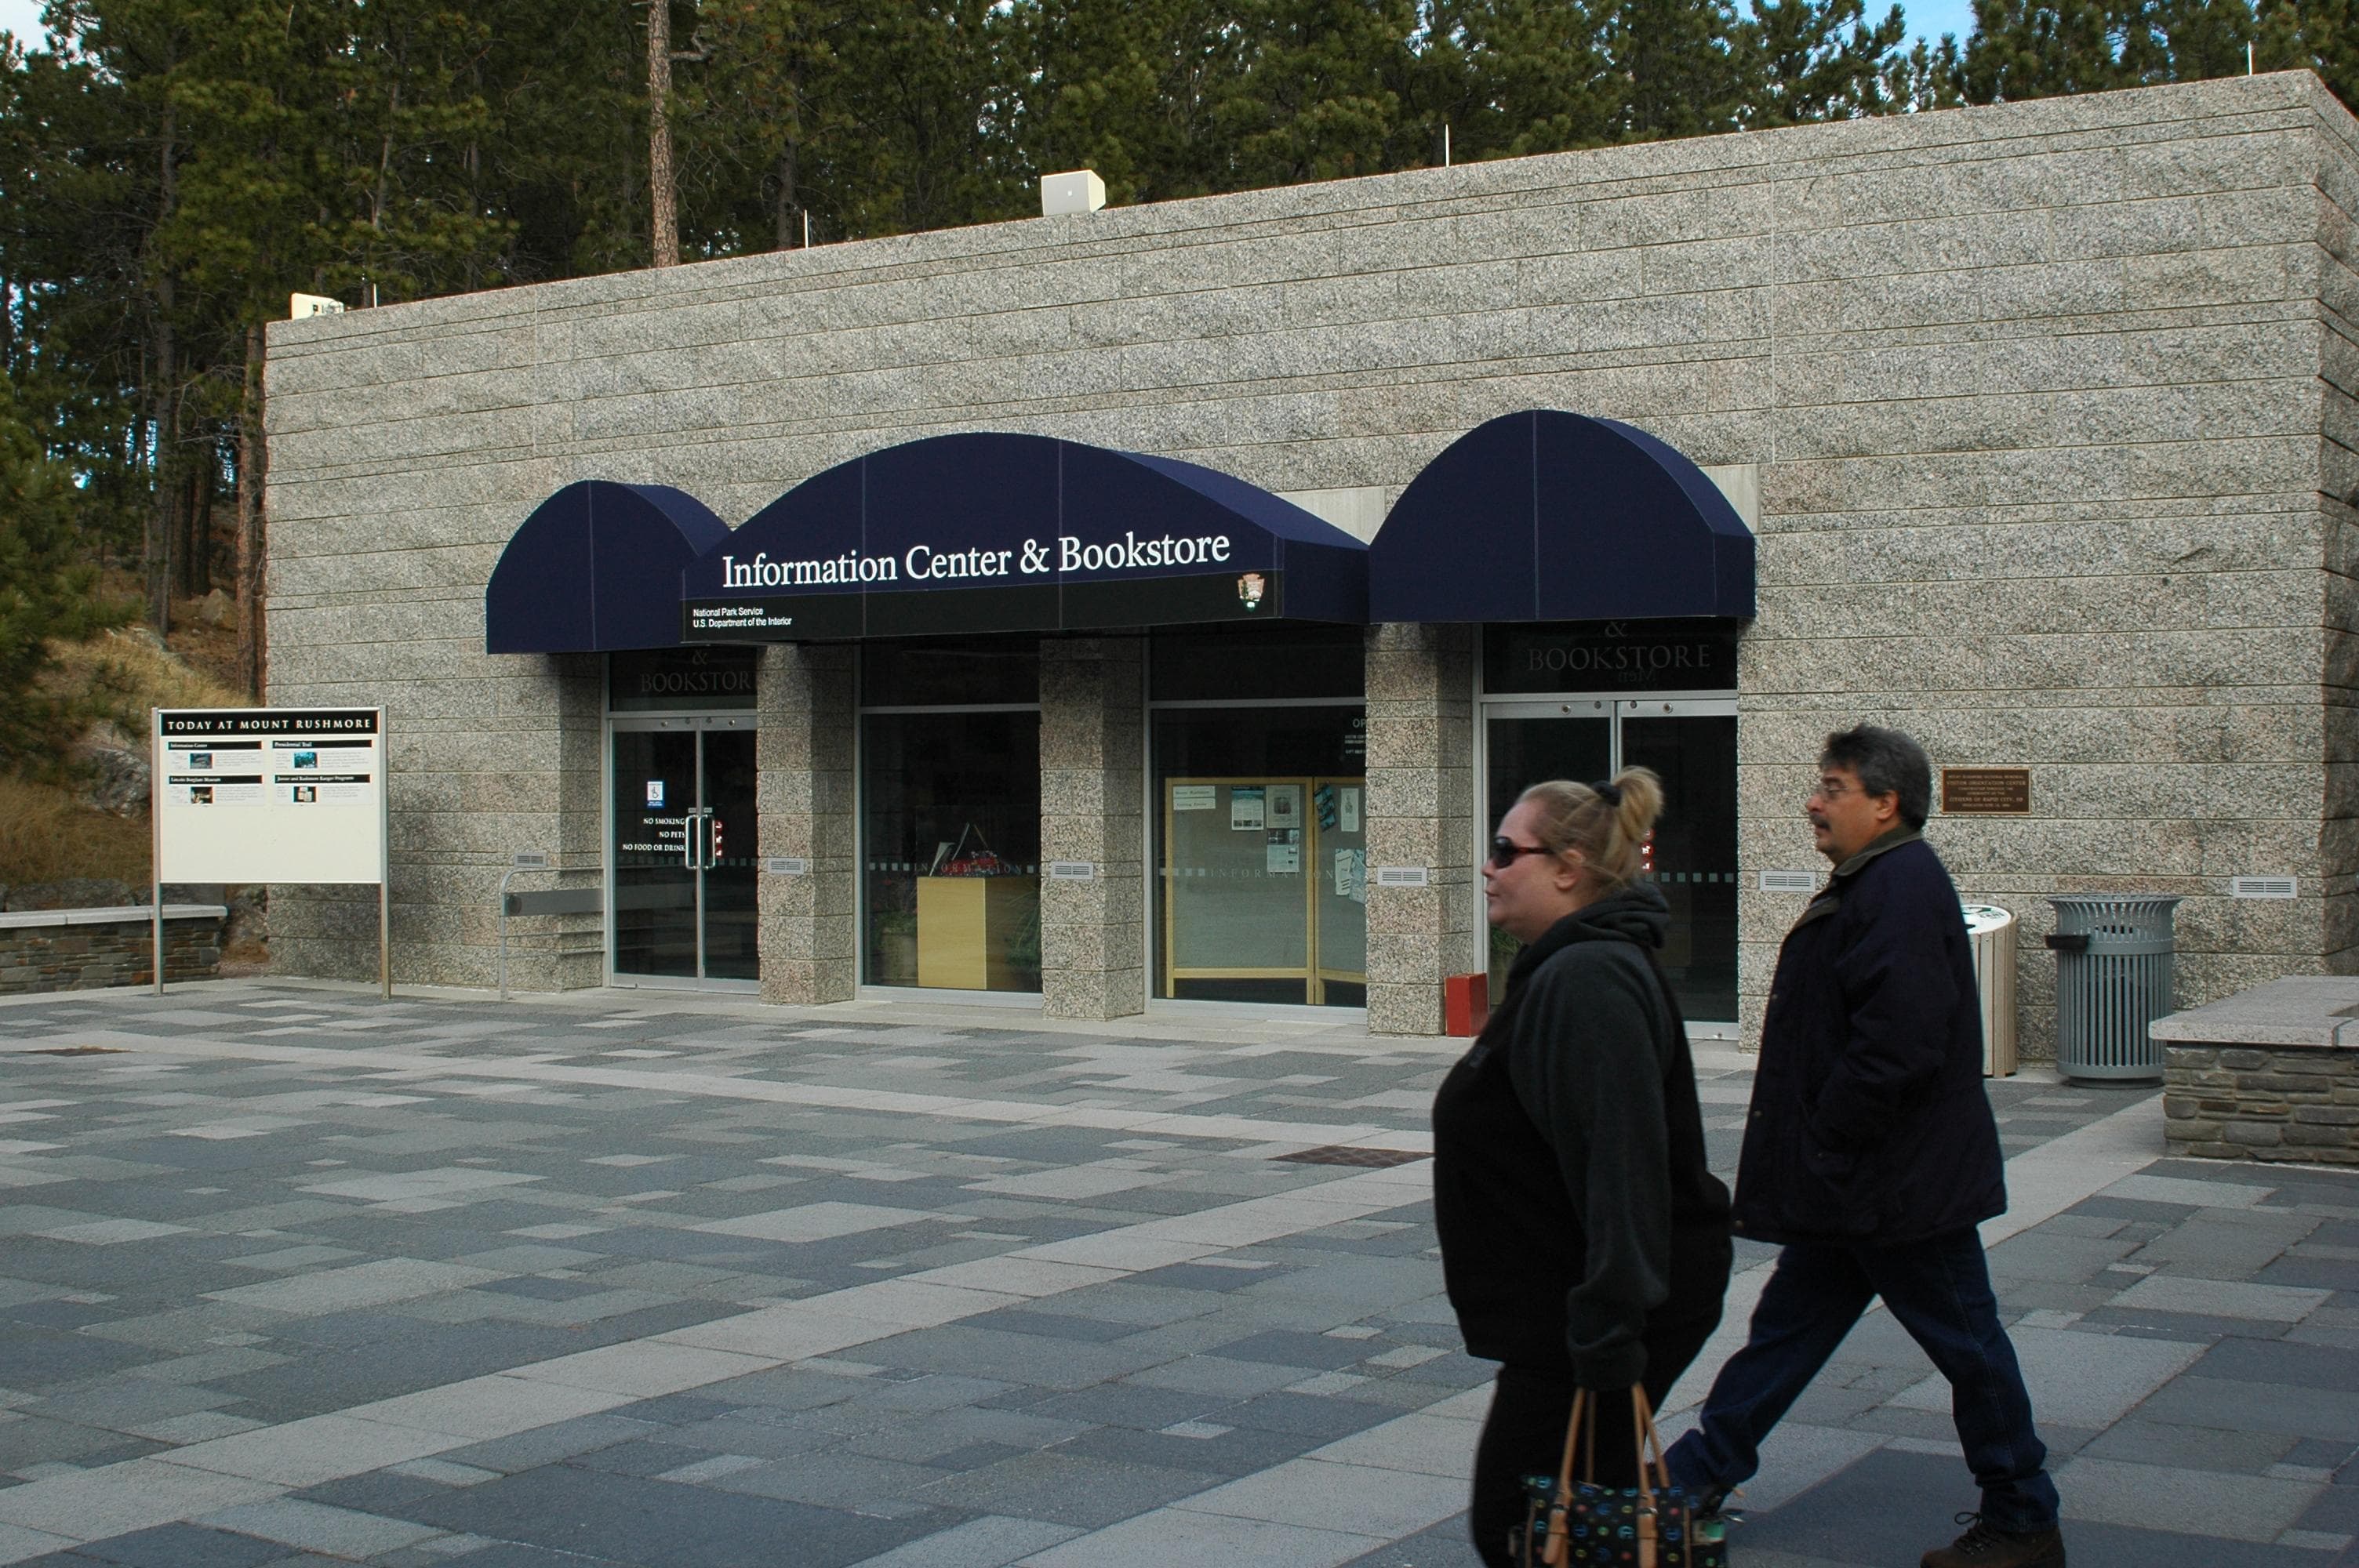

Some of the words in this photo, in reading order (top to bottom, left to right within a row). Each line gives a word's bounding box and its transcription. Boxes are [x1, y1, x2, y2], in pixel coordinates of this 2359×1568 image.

[722, 549, 898, 588] Information
[905, 545, 1012, 579] Center
[1020, 539, 1050, 574] &
[1058, 531, 1230, 572] Bookstore
[692, 608, 721, 617] National
[722, 608, 738, 616] Park
[738, 607, 764, 616] Service
[708, 619, 747, 629] Department
[747, 617, 755, 626] of
[756, 617, 767, 626] the
[768, 616, 792, 626] Interior
[1605, 621, 1629, 638] &
[1528, 644, 1712, 671] BOOKSTORE
[639, 670, 753, 693] BOOKSTOR
[167, 720, 213, 730] TODAY
[217, 720, 233, 730] AT
[239, 720, 289, 729] MOUNT
[296, 719, 371, 728] RUSHMORE
[643, 817, 654, 826] NO
[655, 817, 685, 826] SMOKING
